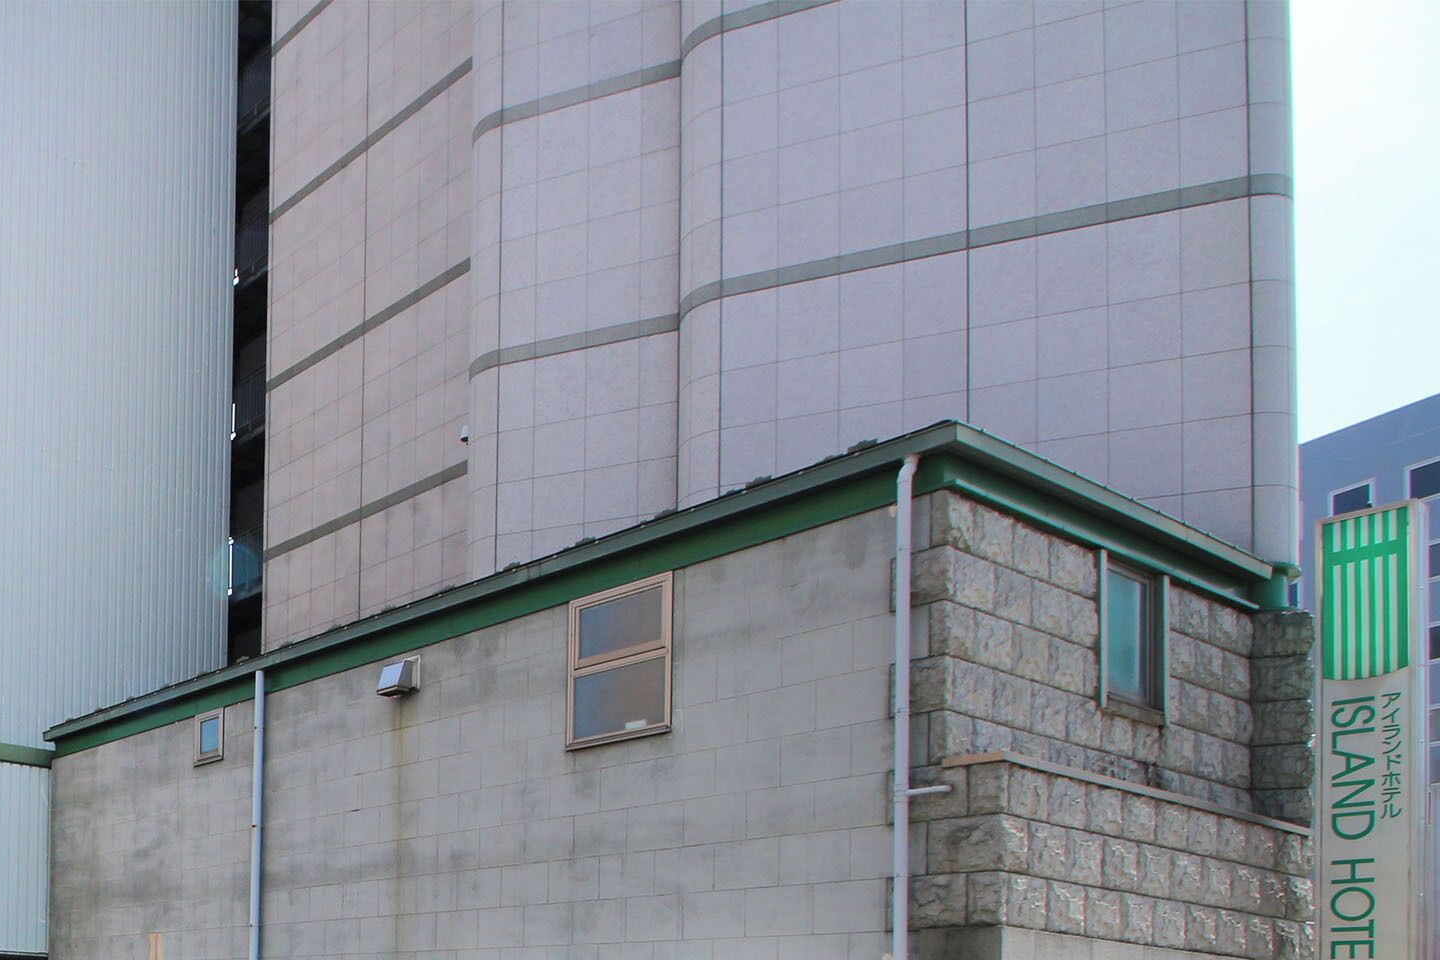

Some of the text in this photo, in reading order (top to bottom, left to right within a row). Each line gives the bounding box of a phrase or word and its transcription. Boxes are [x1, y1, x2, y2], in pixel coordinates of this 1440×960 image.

[1331, 695, 1376, 841] ISLAND
[1380, 692, 1403, 820] アイランドホテル
